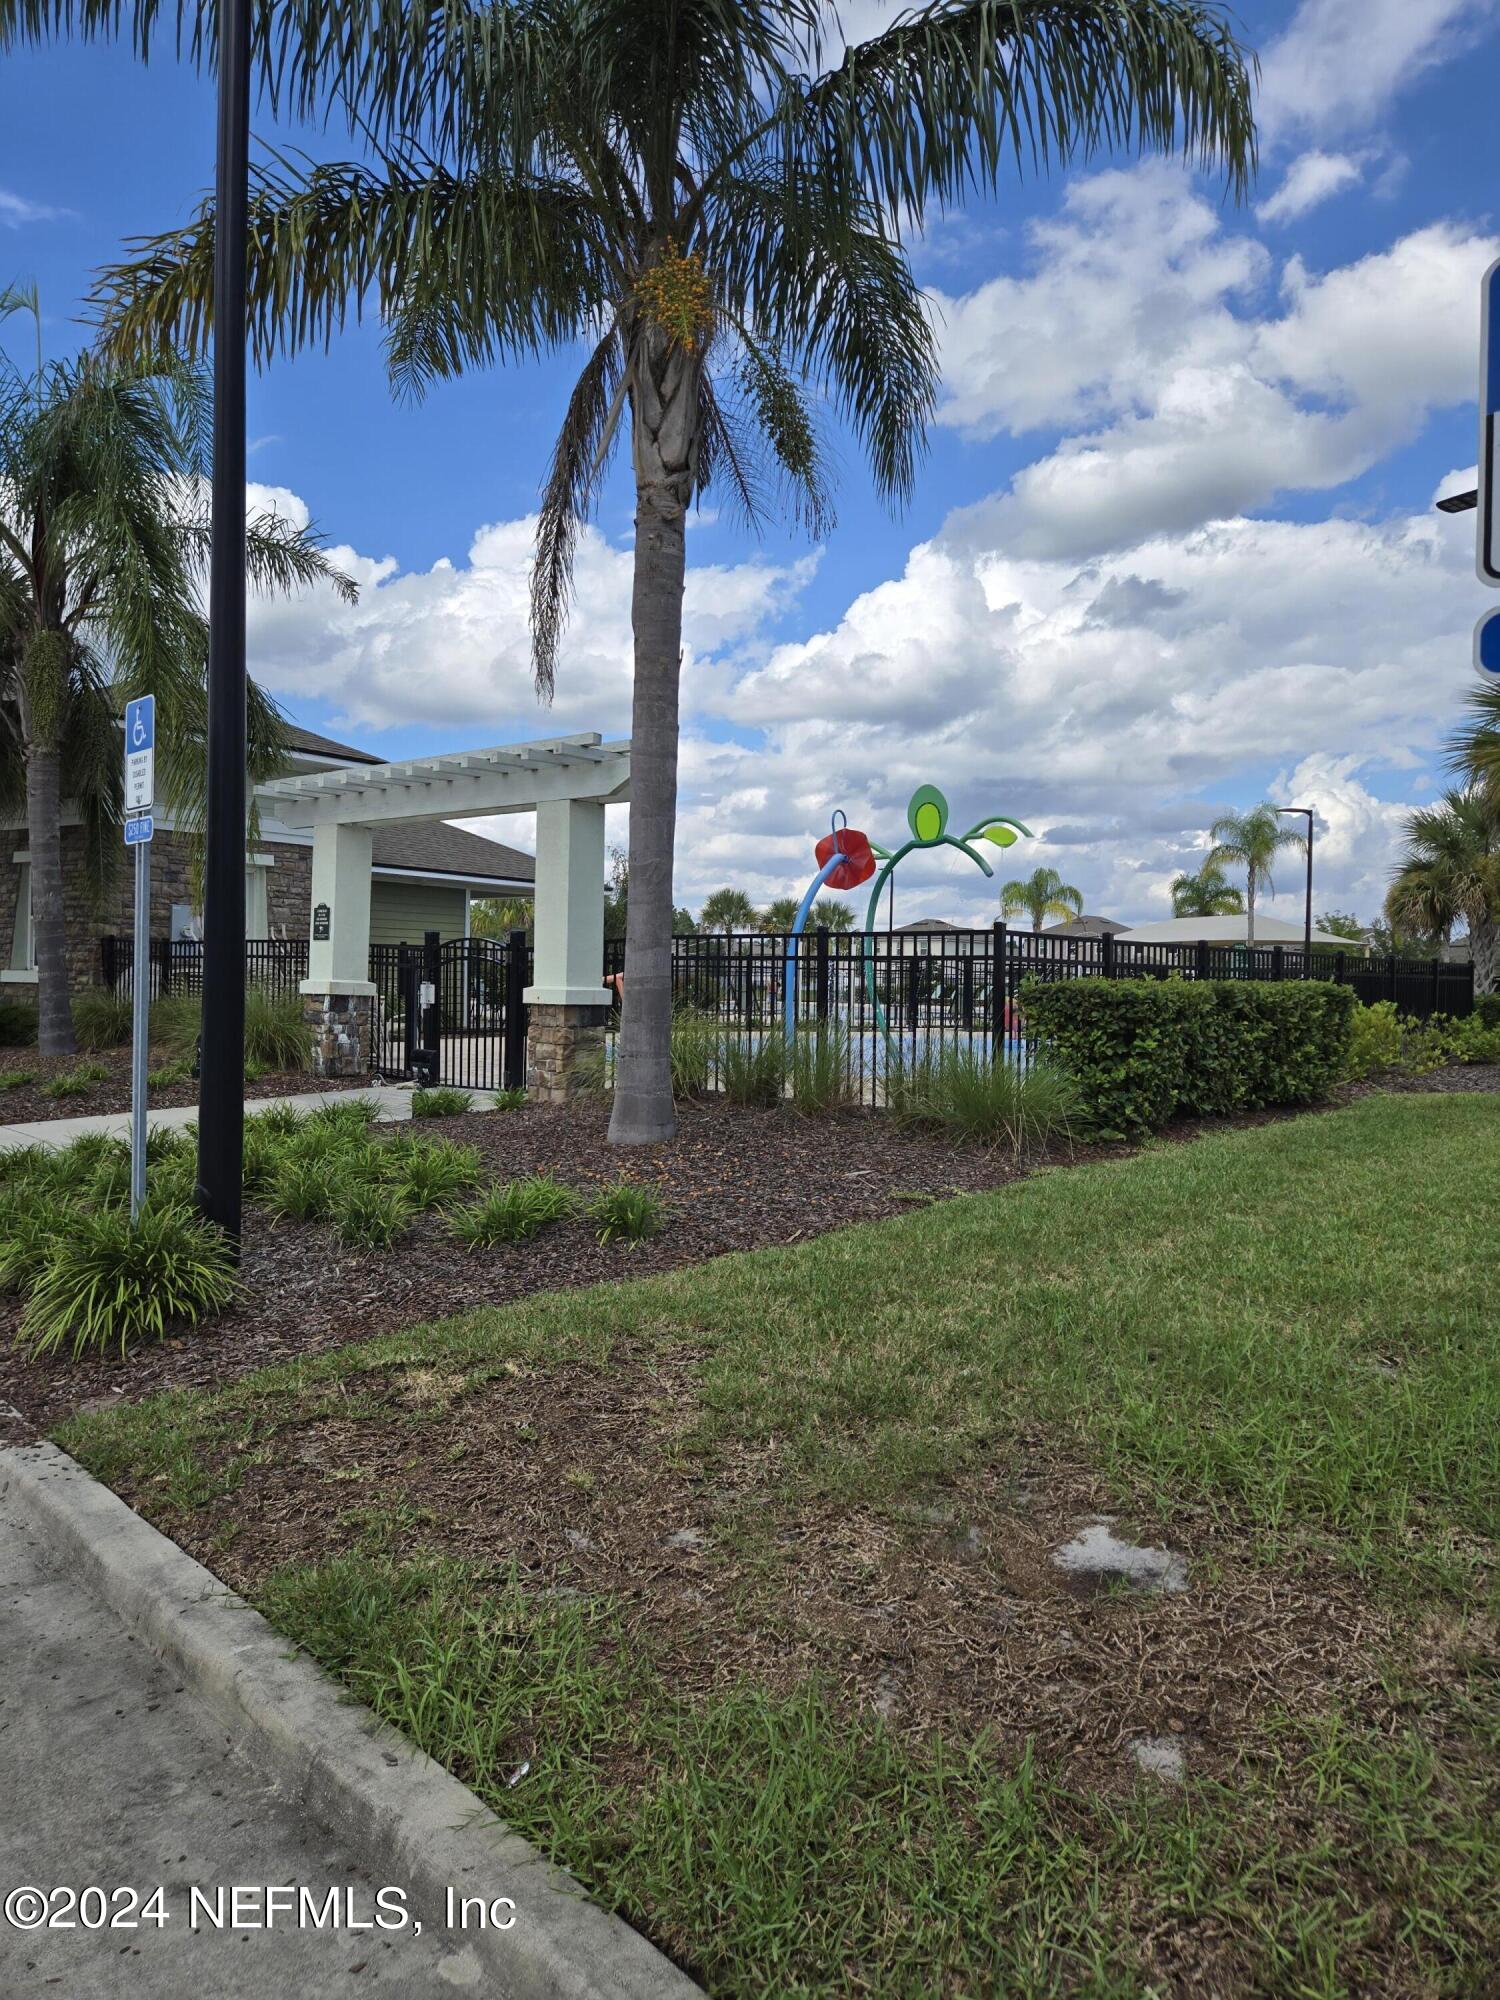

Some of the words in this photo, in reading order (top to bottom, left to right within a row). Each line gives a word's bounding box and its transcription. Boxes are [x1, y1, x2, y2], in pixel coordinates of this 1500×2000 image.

[134, 781, 144, 790] PERMIT
[128, 823, 139, 836] $250
[139, 820, 150, 834] FINE
